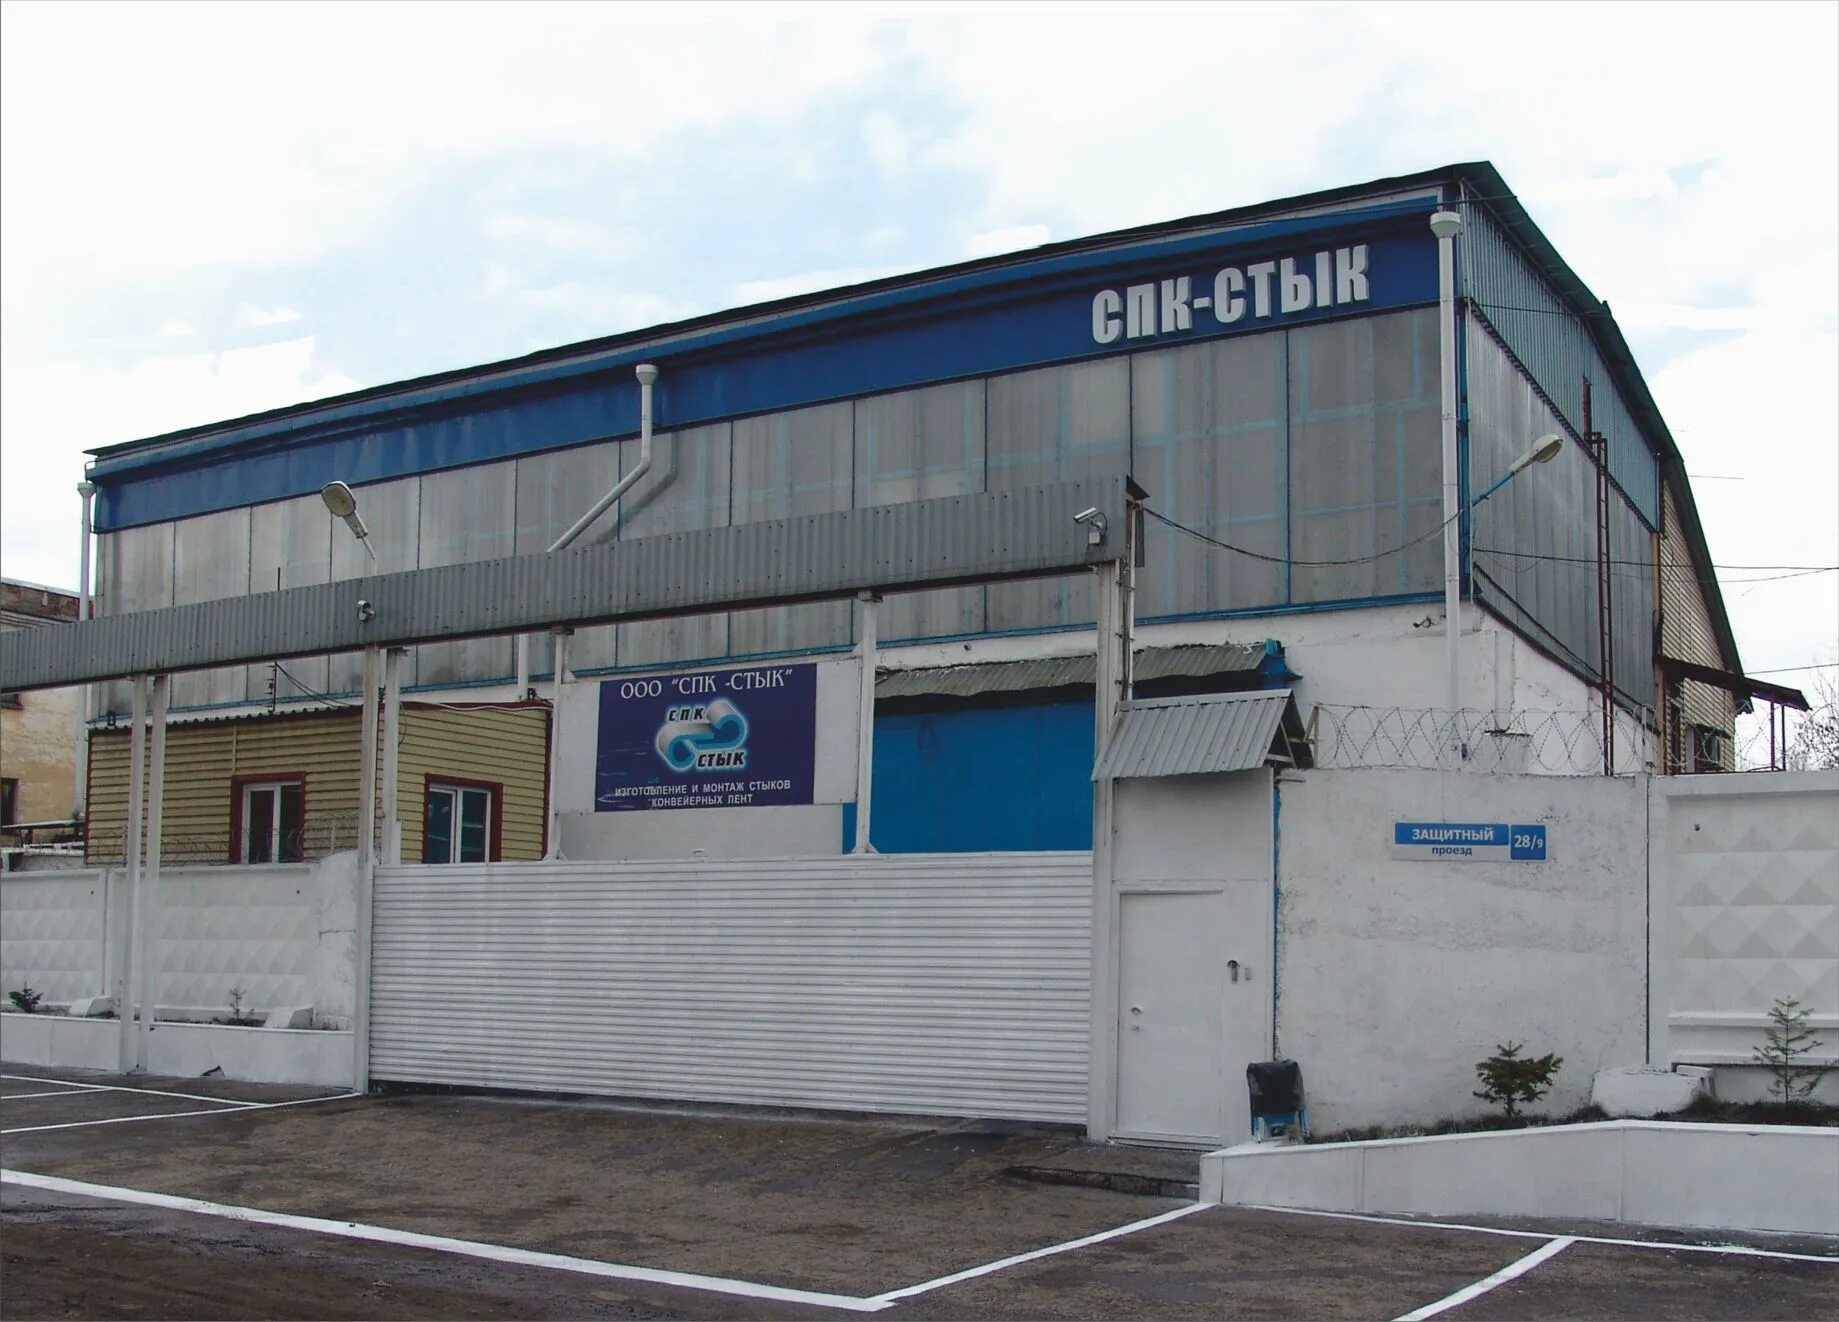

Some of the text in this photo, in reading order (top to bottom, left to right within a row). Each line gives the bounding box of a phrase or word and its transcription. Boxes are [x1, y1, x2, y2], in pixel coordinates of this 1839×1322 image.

[1092, 244, 1369, 344] СПК-СТЫК
[620, 679, 662, 699] ООО
[668, 707, 705, 722] СПК
[697, 751, 745, 768] СТЫК
[615, 779, 791, 797] ИЗГОТОВЛЕНИЕ И МОНТАЖ СТЫКОВ
[651, 794, 753, 808] КОНВЕЙЕРНЫХ ЛЕНТ
[1412, 826, 1494, 842] ЗАЩИТНЫЙ
[1513, 834, 1544, 850] 28/9
[1432, 847, 1473, 856] проезд
